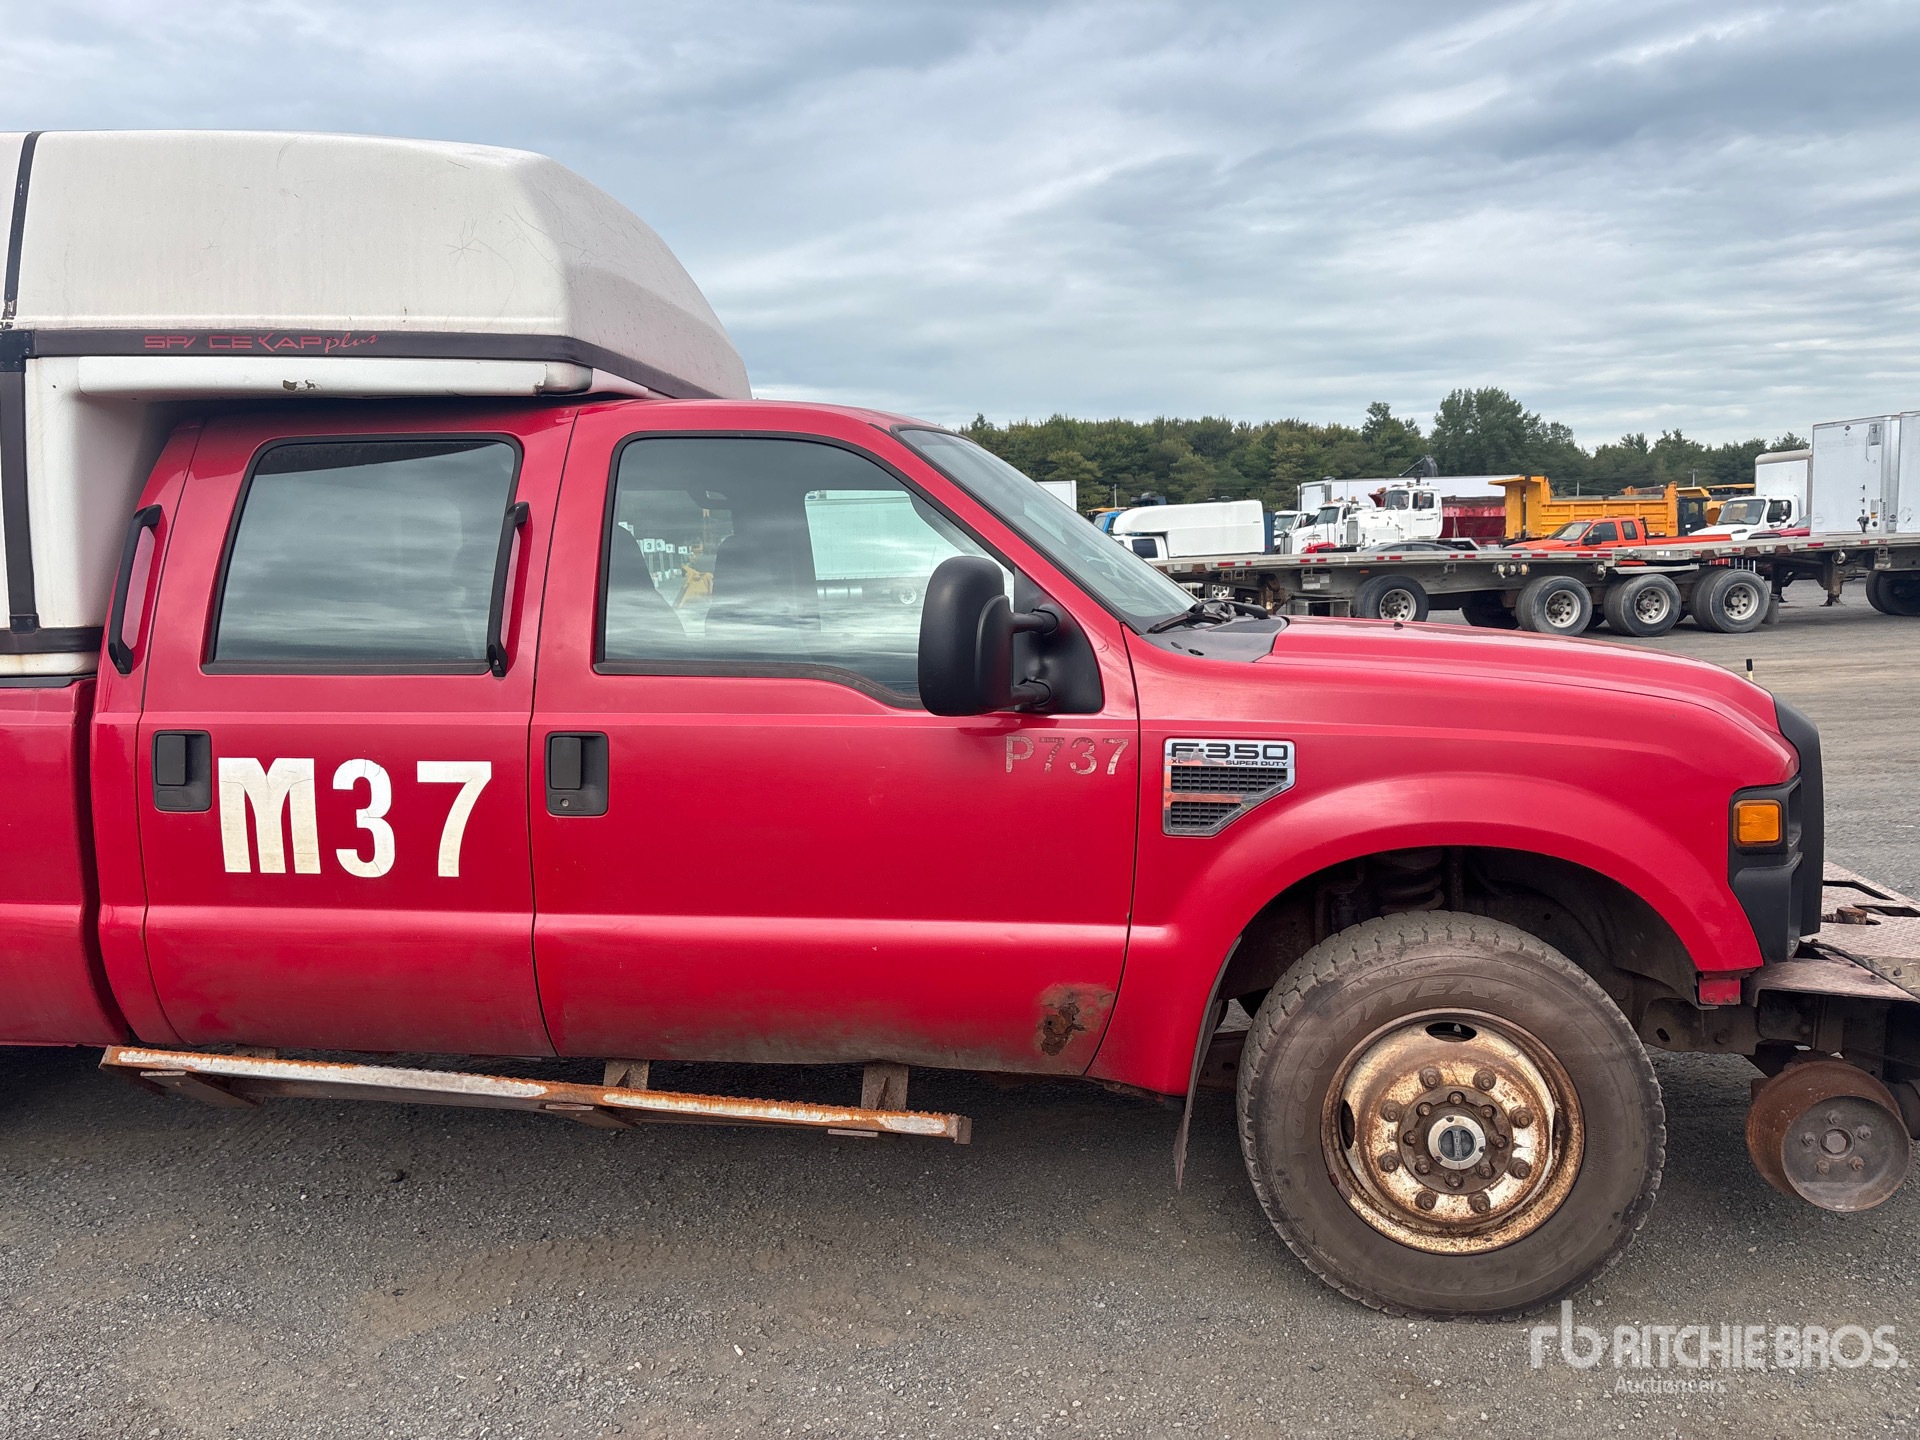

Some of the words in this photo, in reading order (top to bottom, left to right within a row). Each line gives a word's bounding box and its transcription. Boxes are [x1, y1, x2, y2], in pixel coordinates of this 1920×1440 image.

[325, 332, 379, 353] plus
[1005, 735, 1129, 775] P737
[1171, 742, 1288, 760] F-350
[1295, 977, 1532, 1138] GOODYEAR
